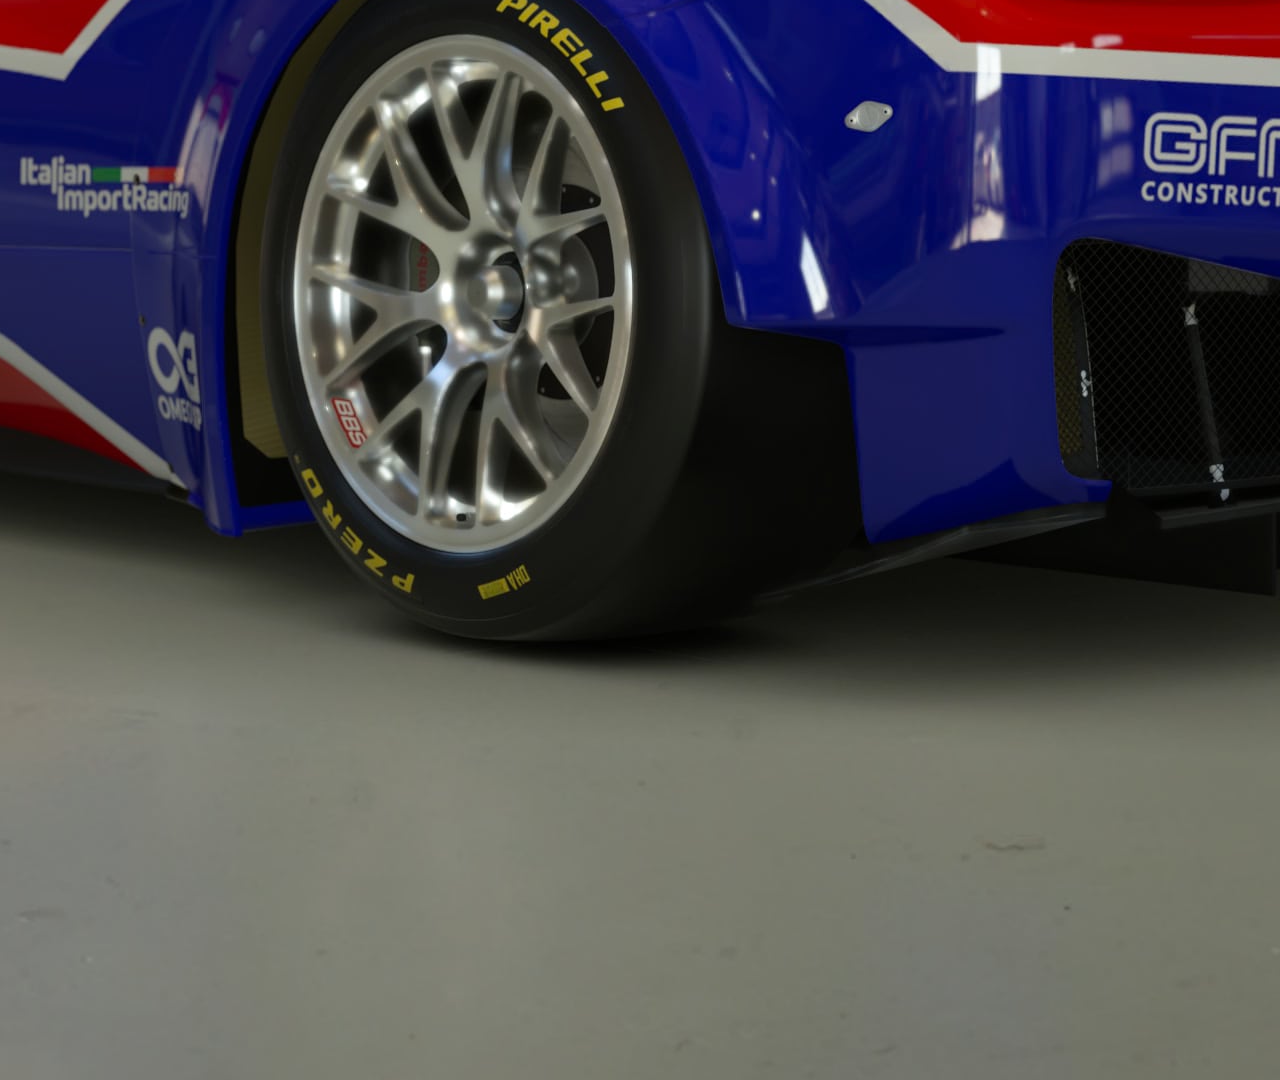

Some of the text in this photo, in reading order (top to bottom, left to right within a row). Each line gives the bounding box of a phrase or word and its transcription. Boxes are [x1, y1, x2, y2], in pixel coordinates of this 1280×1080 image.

[20, 155, 91, 195] Italian
[57, 184, 189, 219] ImportRacing
[332, 398, 368, 448] BBS
[301, 467, 415, 593] P ZERO
